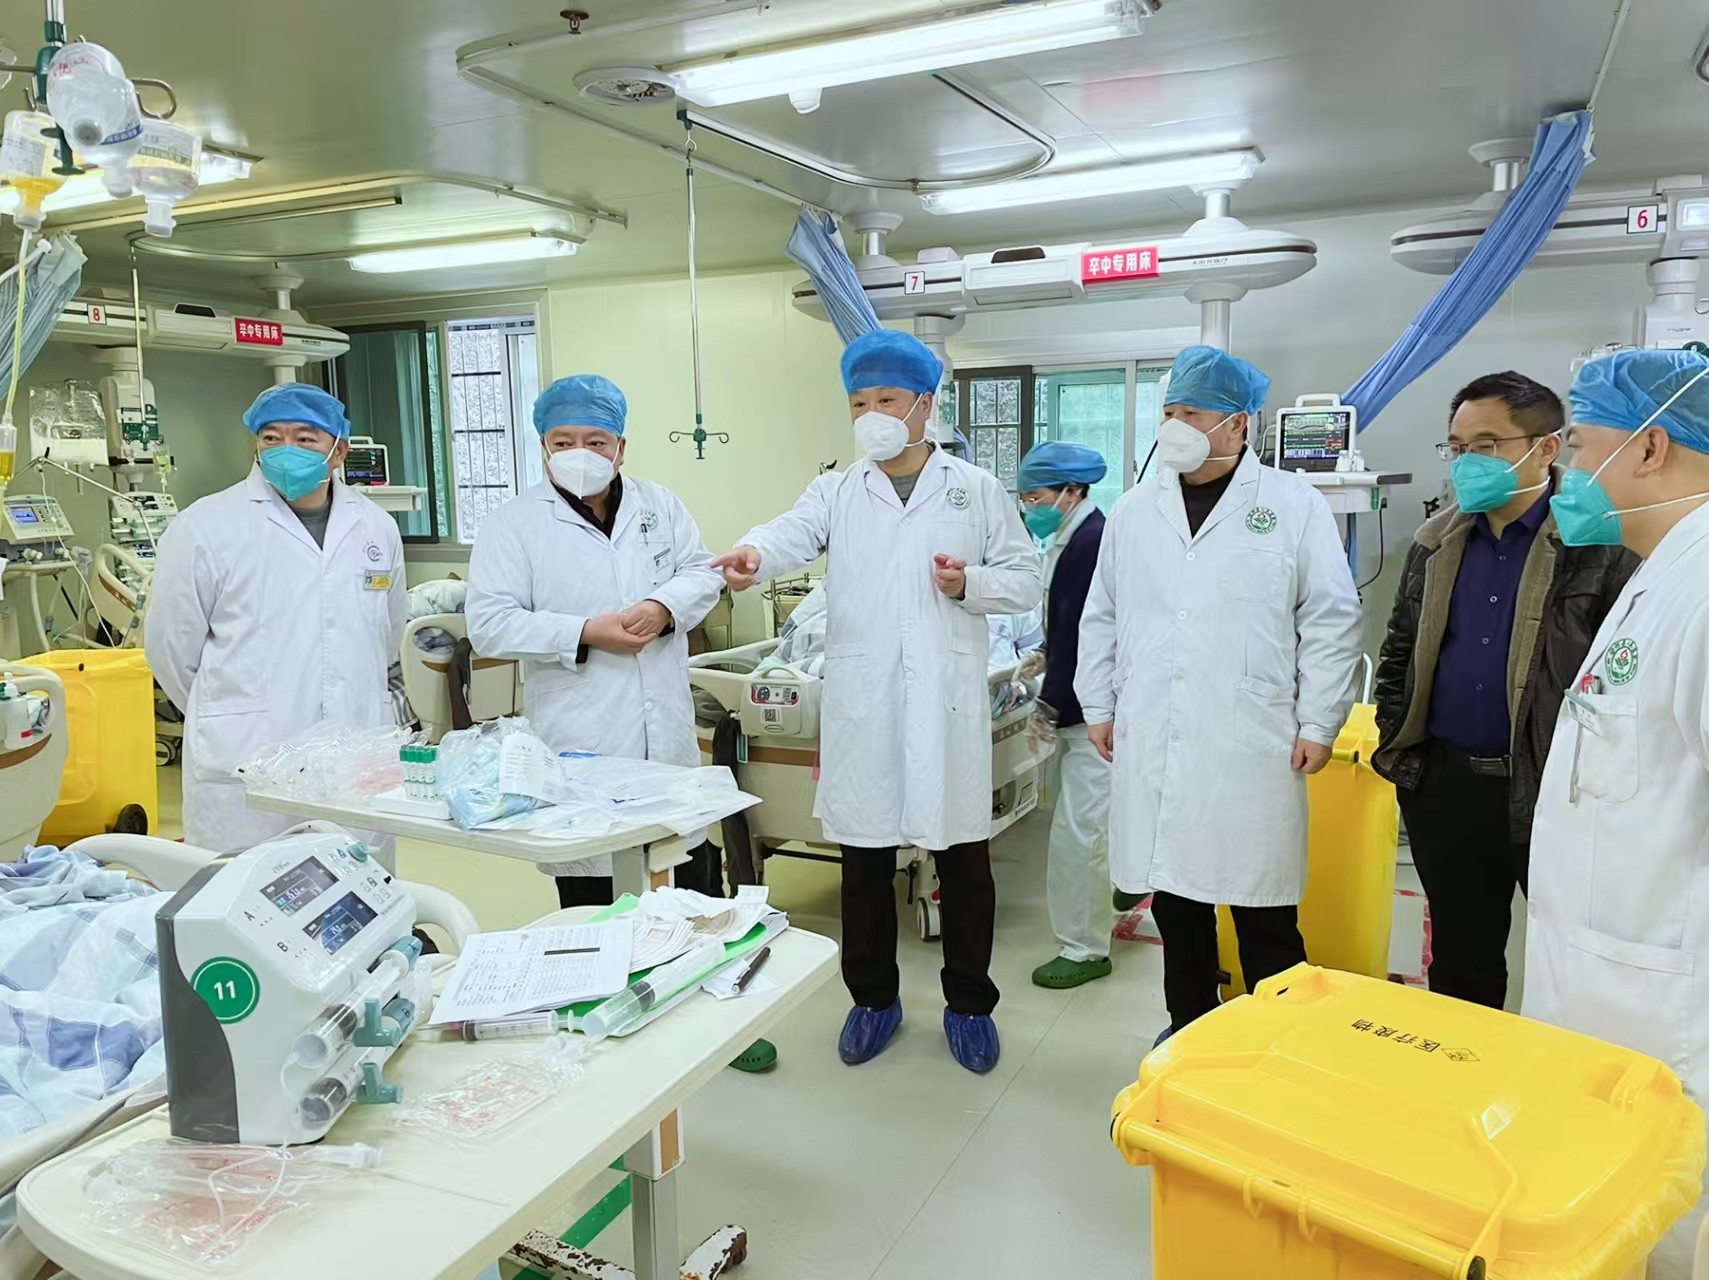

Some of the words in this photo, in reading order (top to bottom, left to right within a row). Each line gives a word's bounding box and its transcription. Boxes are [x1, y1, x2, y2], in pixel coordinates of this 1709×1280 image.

[1637, 210, 1648, 228] 6
[1088, 251, 1151, 276] 卒中专用床
[911, 275, 919, 291] 7
[92, 307, 100, 322] 8
[239, 322, 279, 340] 卒中专用床
[243, 911, 256, 921] A
[276, 941, 289, 953] B
[213, 980, 237, 1001] 11
